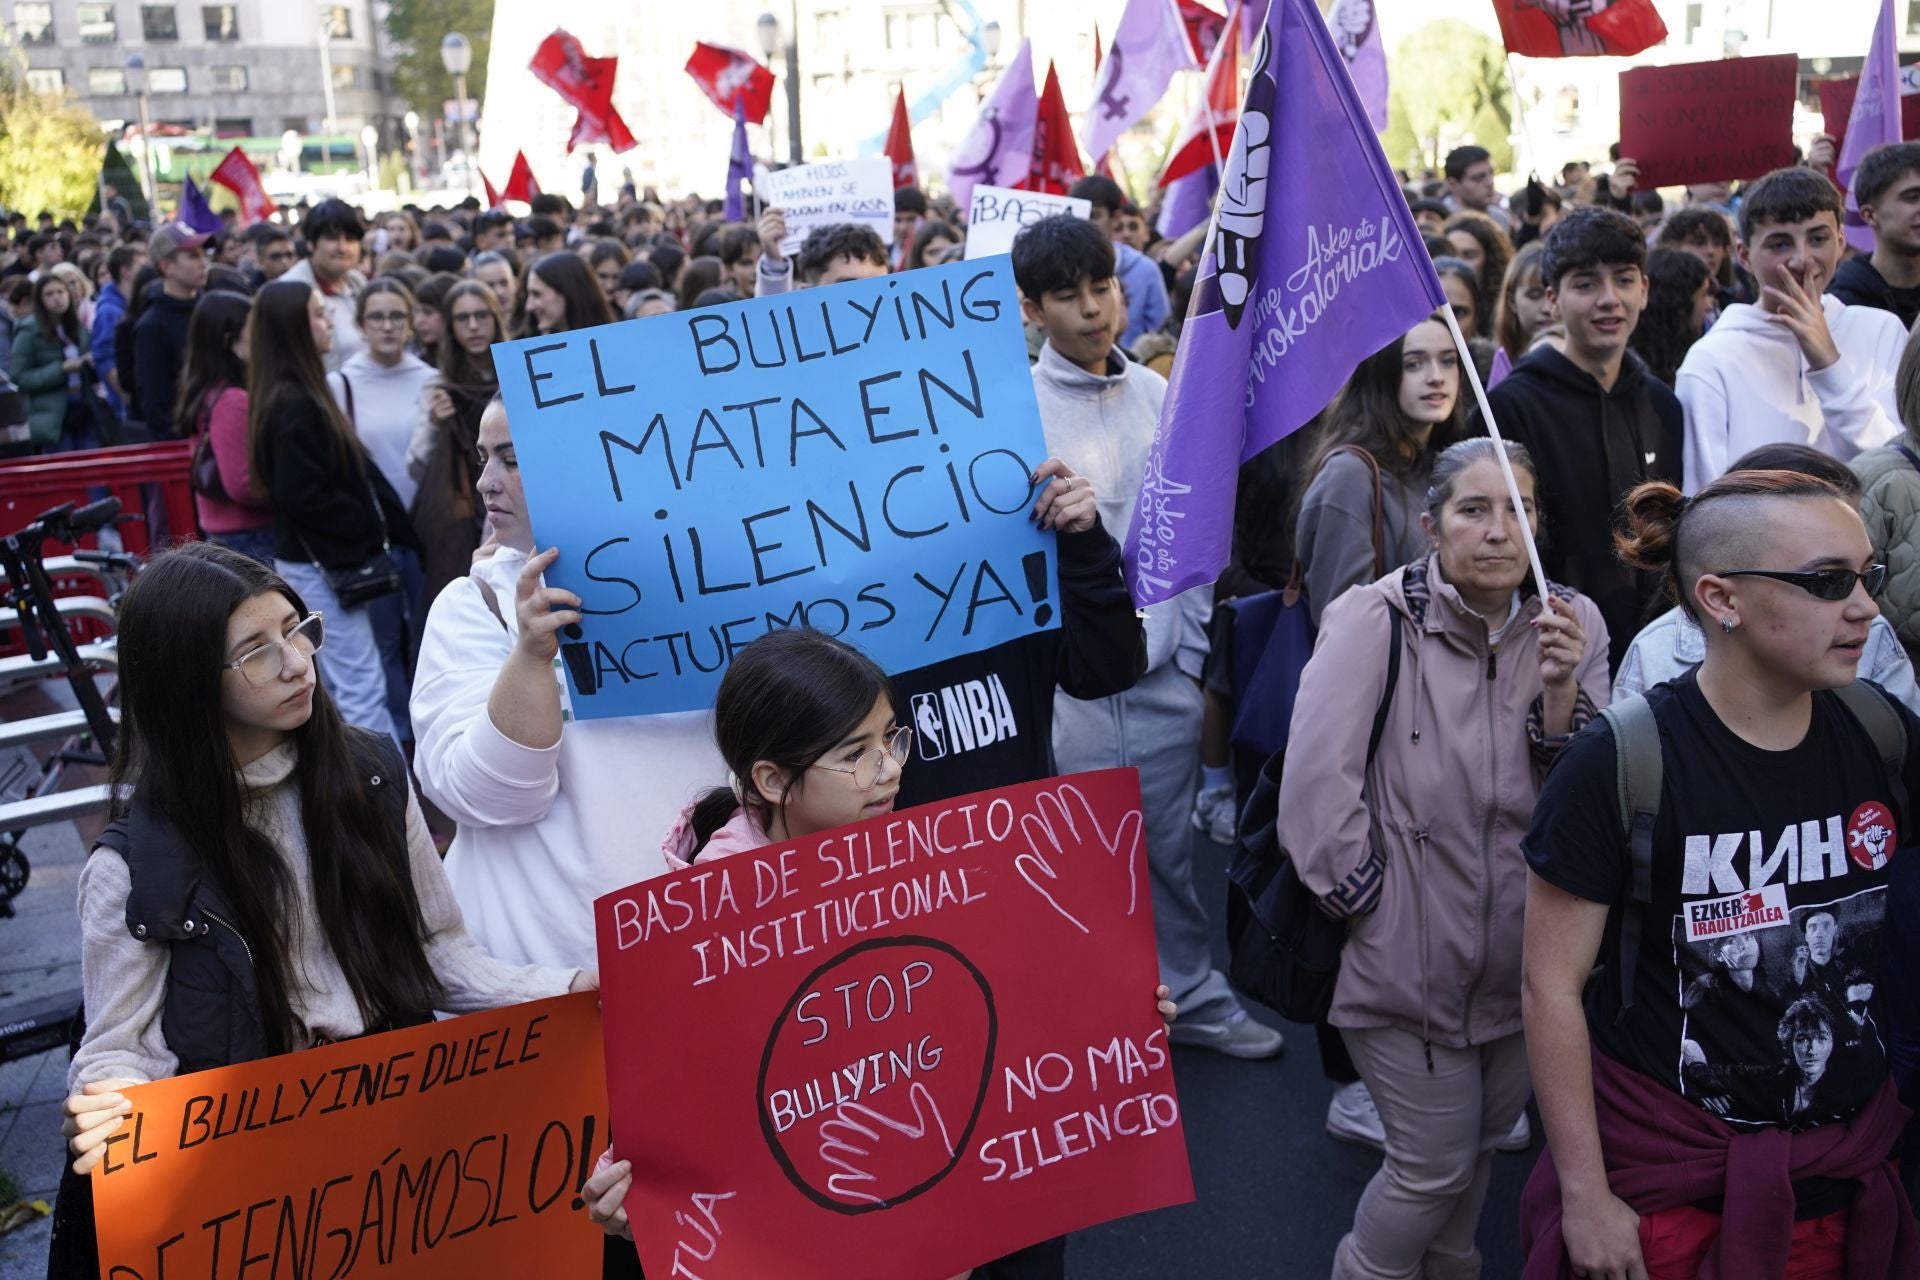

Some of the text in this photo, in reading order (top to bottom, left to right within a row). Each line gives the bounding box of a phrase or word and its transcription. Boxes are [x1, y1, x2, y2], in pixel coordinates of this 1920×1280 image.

[841, 181, 857, 195] SE
[852, 198, 887, 211] CASA
[1287, 224, 1353, 293] Aske
[1355, 217, 1377, 242] eta
[524, 338, 636, 409] EL
[599, 349, 985, 502] MATA EN
[1153, 452, 1192, 574] Aske eta
[913, 551, 1053, 642] YA!
[940, 673, 1018, 754] NBA
[614, 797, 1014, 950] BASTA DE SILENCIO
[1681, 815, 1848, 894] КИН
[692, 867, 987, 987] INSTITUCIONAL
[1691, 898, 1742, 922] EZKER
[1692, 906, 1784, 936] IRAULTZAILEA
[795, 961, 934, 1046] STOP
[103, 1014, 549, 1176] EL BULLYING DUELE
[769, 1035, 943, 1133] BULLYING
[1003, 1029, 1167, 1113] NO MAS
[979, 1091, 1178, 1181] SILENCIO
